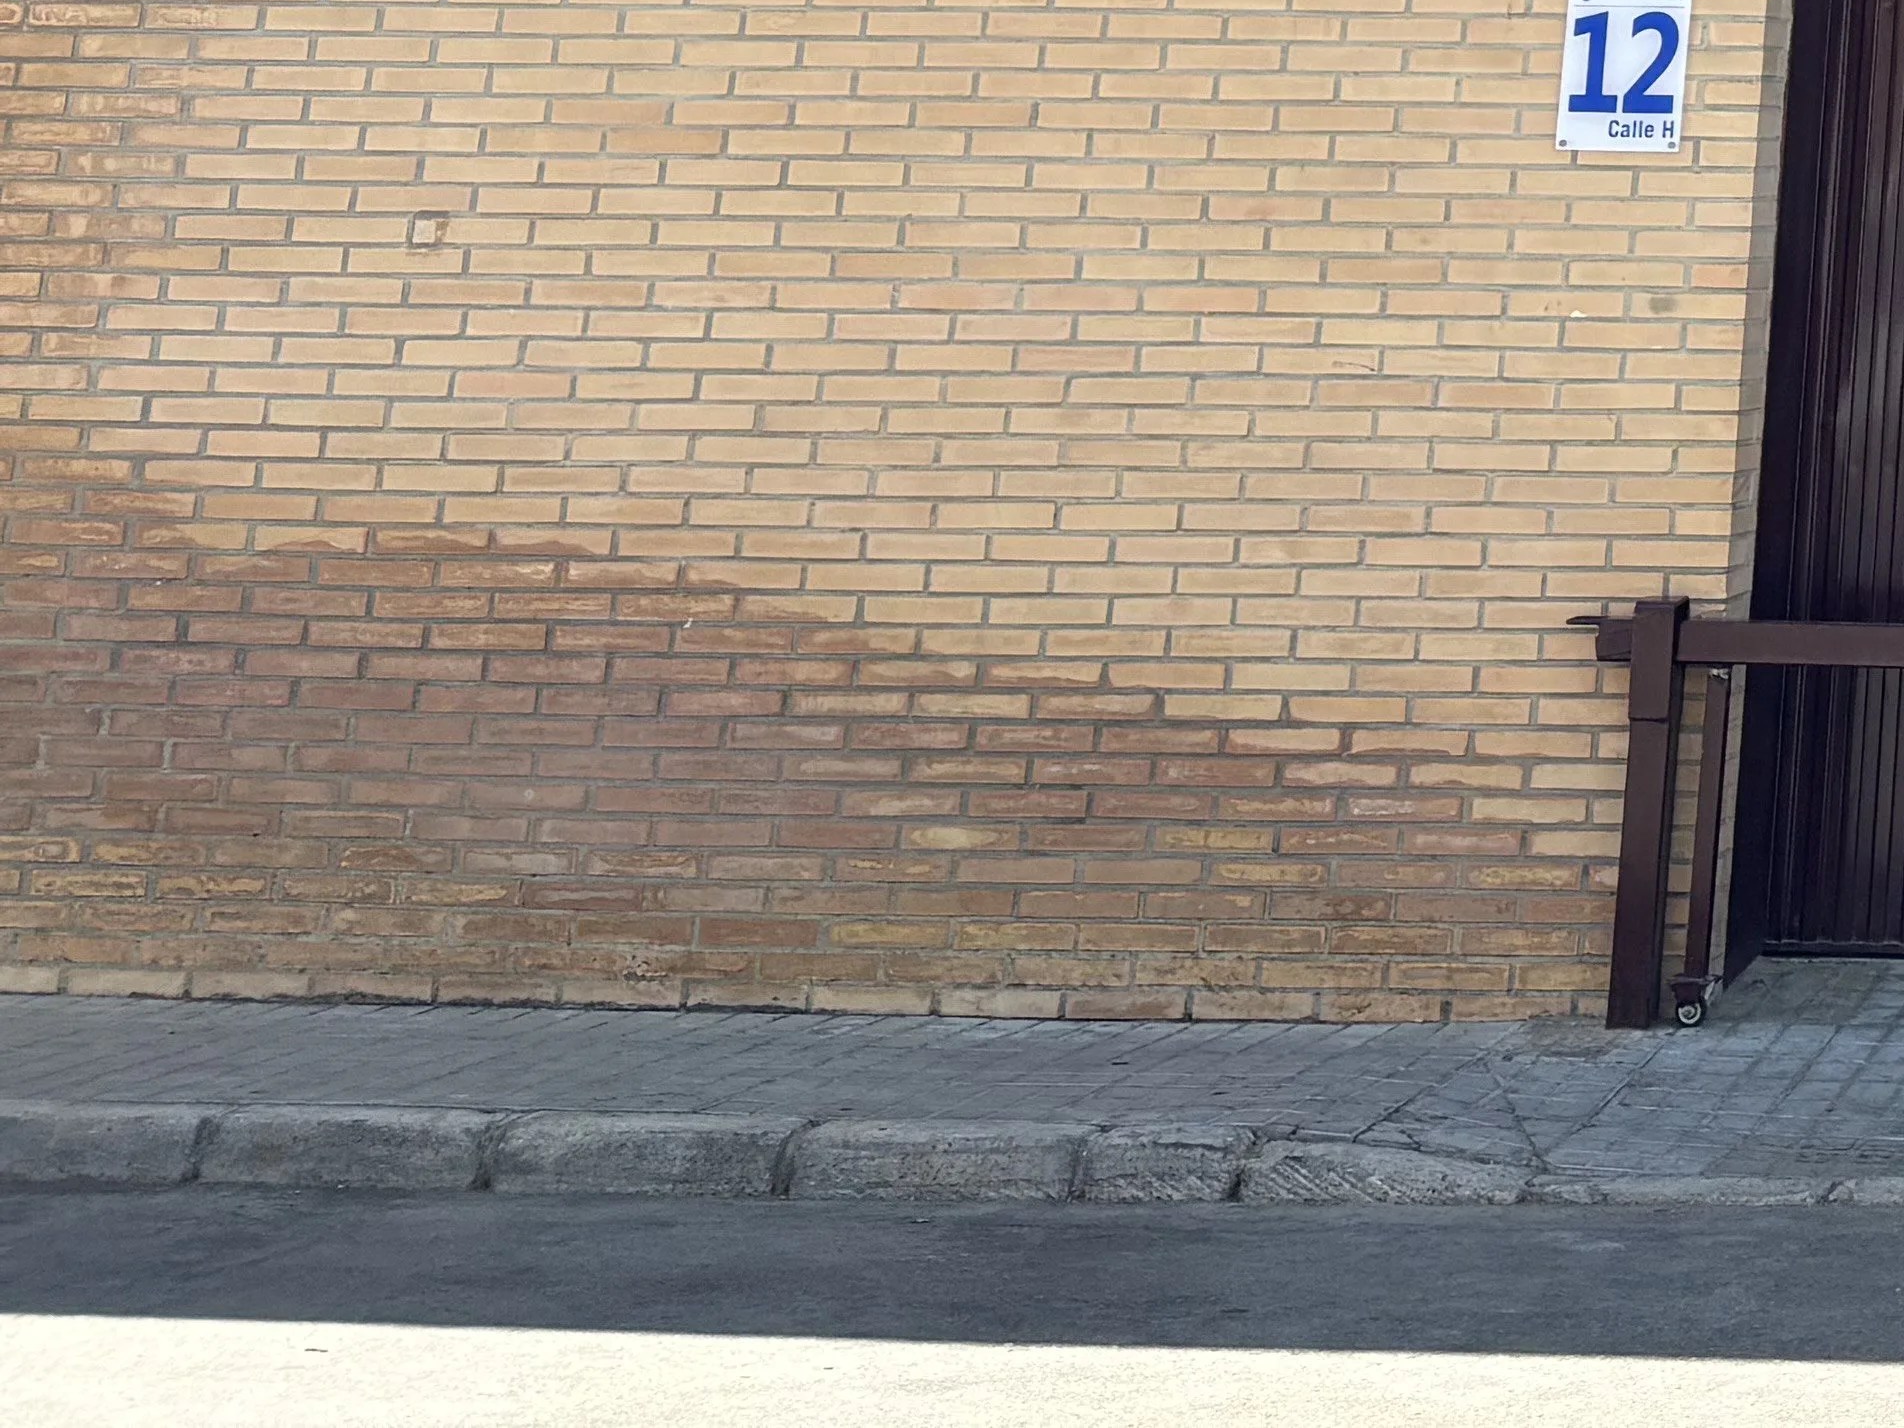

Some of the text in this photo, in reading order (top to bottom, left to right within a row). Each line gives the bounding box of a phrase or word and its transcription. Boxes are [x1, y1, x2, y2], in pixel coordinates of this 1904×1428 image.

[1568, 11, 1679, 114] 12
[1608, 120, 1675, 138] Calle H
